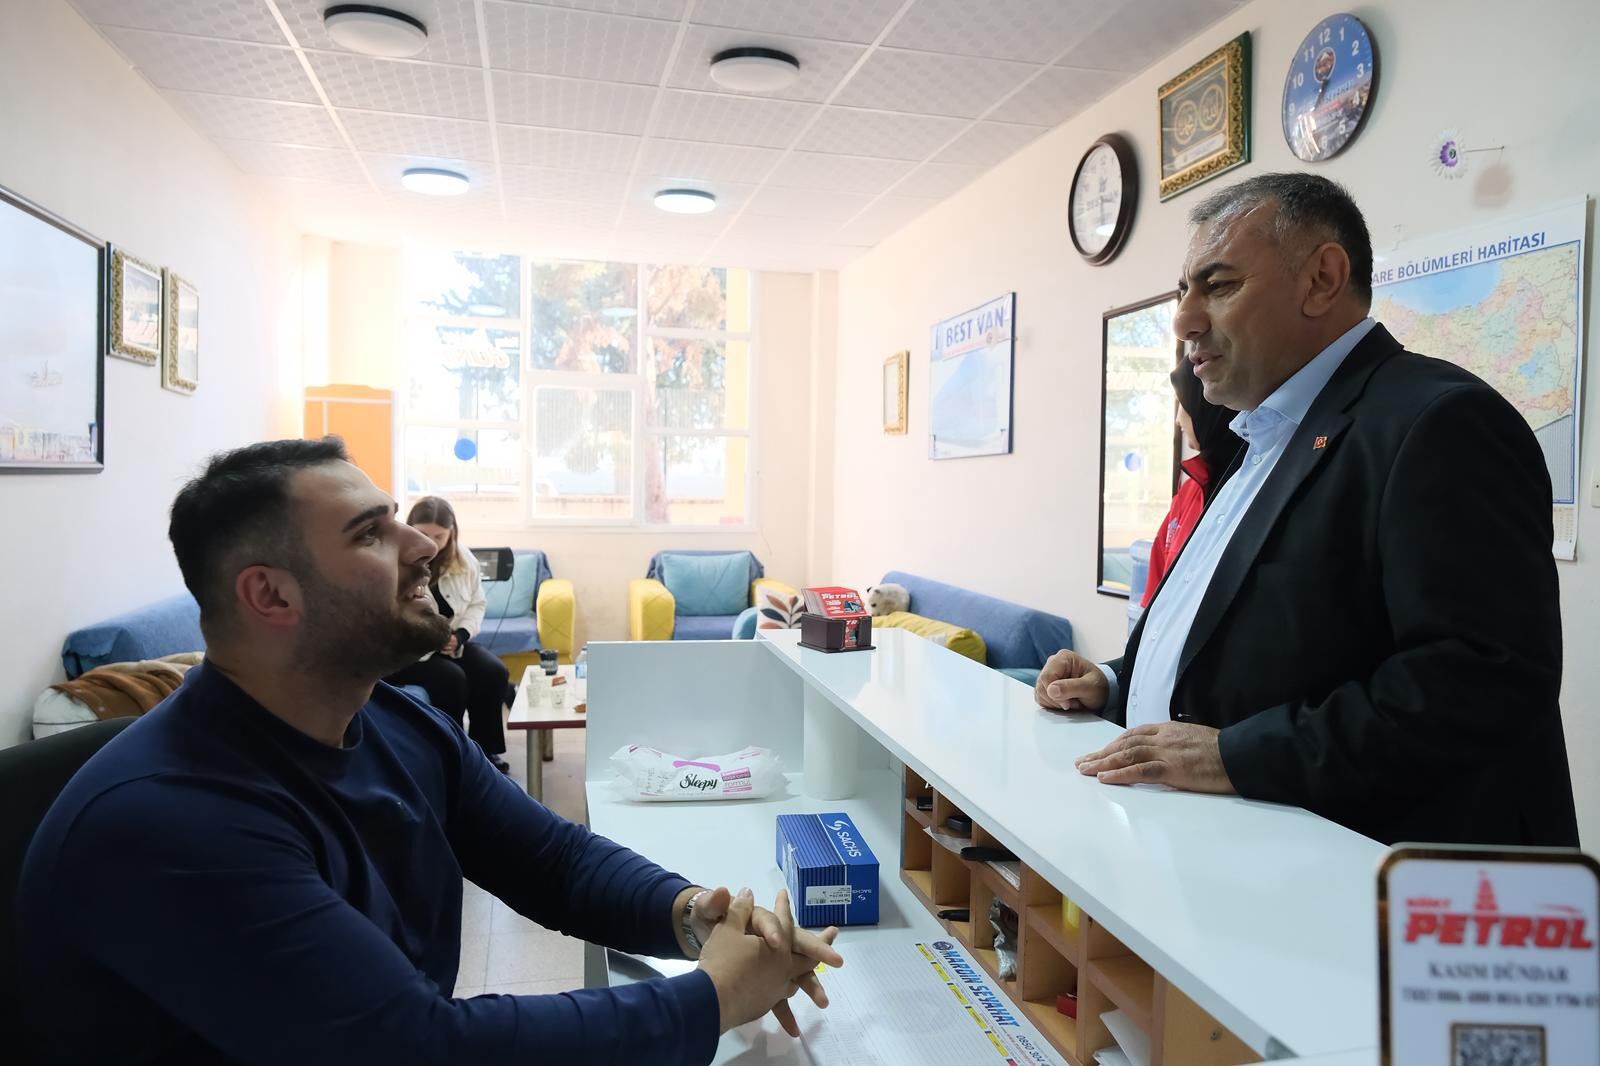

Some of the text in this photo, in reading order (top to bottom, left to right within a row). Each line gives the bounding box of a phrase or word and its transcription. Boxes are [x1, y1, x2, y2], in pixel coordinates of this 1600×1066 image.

[1320, 27, 1331, 46] 12
[1339, 26, 1345, 41] 1
[1304, 45, 1315, 62] 11
[1352, 40, 1359, 56] 2
[1356, 63, 1364, 78] 3
[1292, 72, 1304, 88] 10
[1352, 90, 1360, 105] 4
[1288, 103, 1295, 116] 9
[1338, 119, 1346, 135] 5
[1398, 246, 1473, 279] BÖLÜMLERİ
[1478, 232, 1546, 260] HARİTASI
[946, 305, 1004, 347] BEST VAN
[679, 773, 718, 791] Sleepy
[837, 831, 862, 858] SACHS
[1403, 912, 1595, 949] PETROL
[940, 950, 983, 983] MARDİN
[969, 984, 1021, 1028] SEYAHAT
